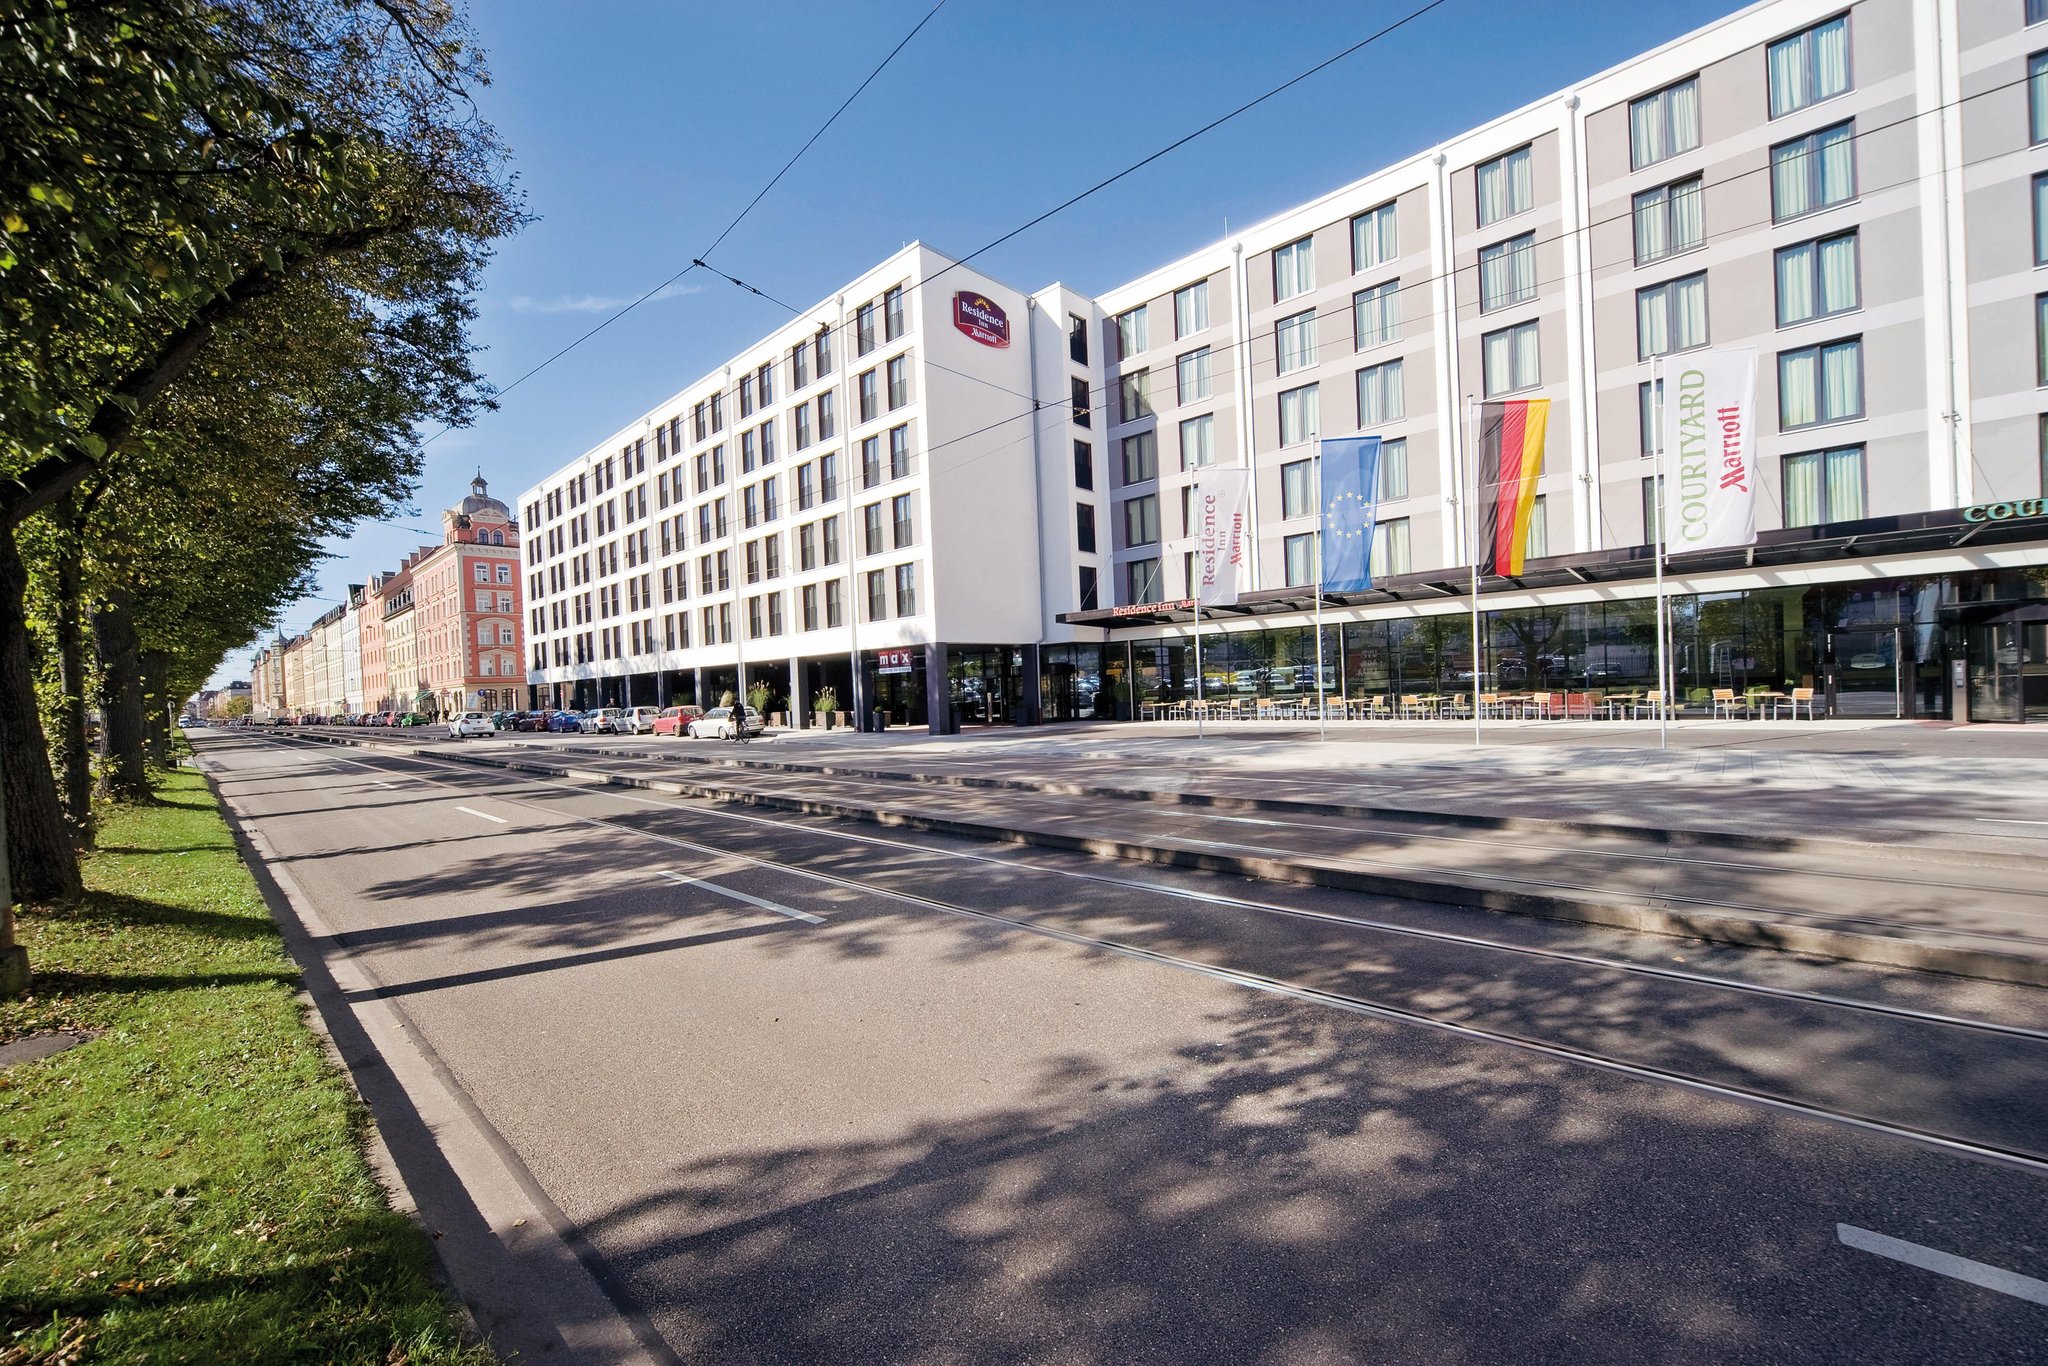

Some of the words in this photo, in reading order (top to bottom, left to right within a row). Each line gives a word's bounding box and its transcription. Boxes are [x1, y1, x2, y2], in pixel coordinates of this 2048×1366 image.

[961, 301, 1004, 328] Residence
[978, 319, 989, 328] Inn
[1679, 369, 1709, 542] COURTYARD
[1717, 406, 1748, 493] Marriott
[1201, 494, 1216, 587] Residence
[1217, 530, 1226, 551] Inn
[1230, 512, 1243, 568] Marriott
[1112, 603, 1157, 617] Residence
[1157, 602, 1176, 611] Inn
[879, 653, 910, 665] max
